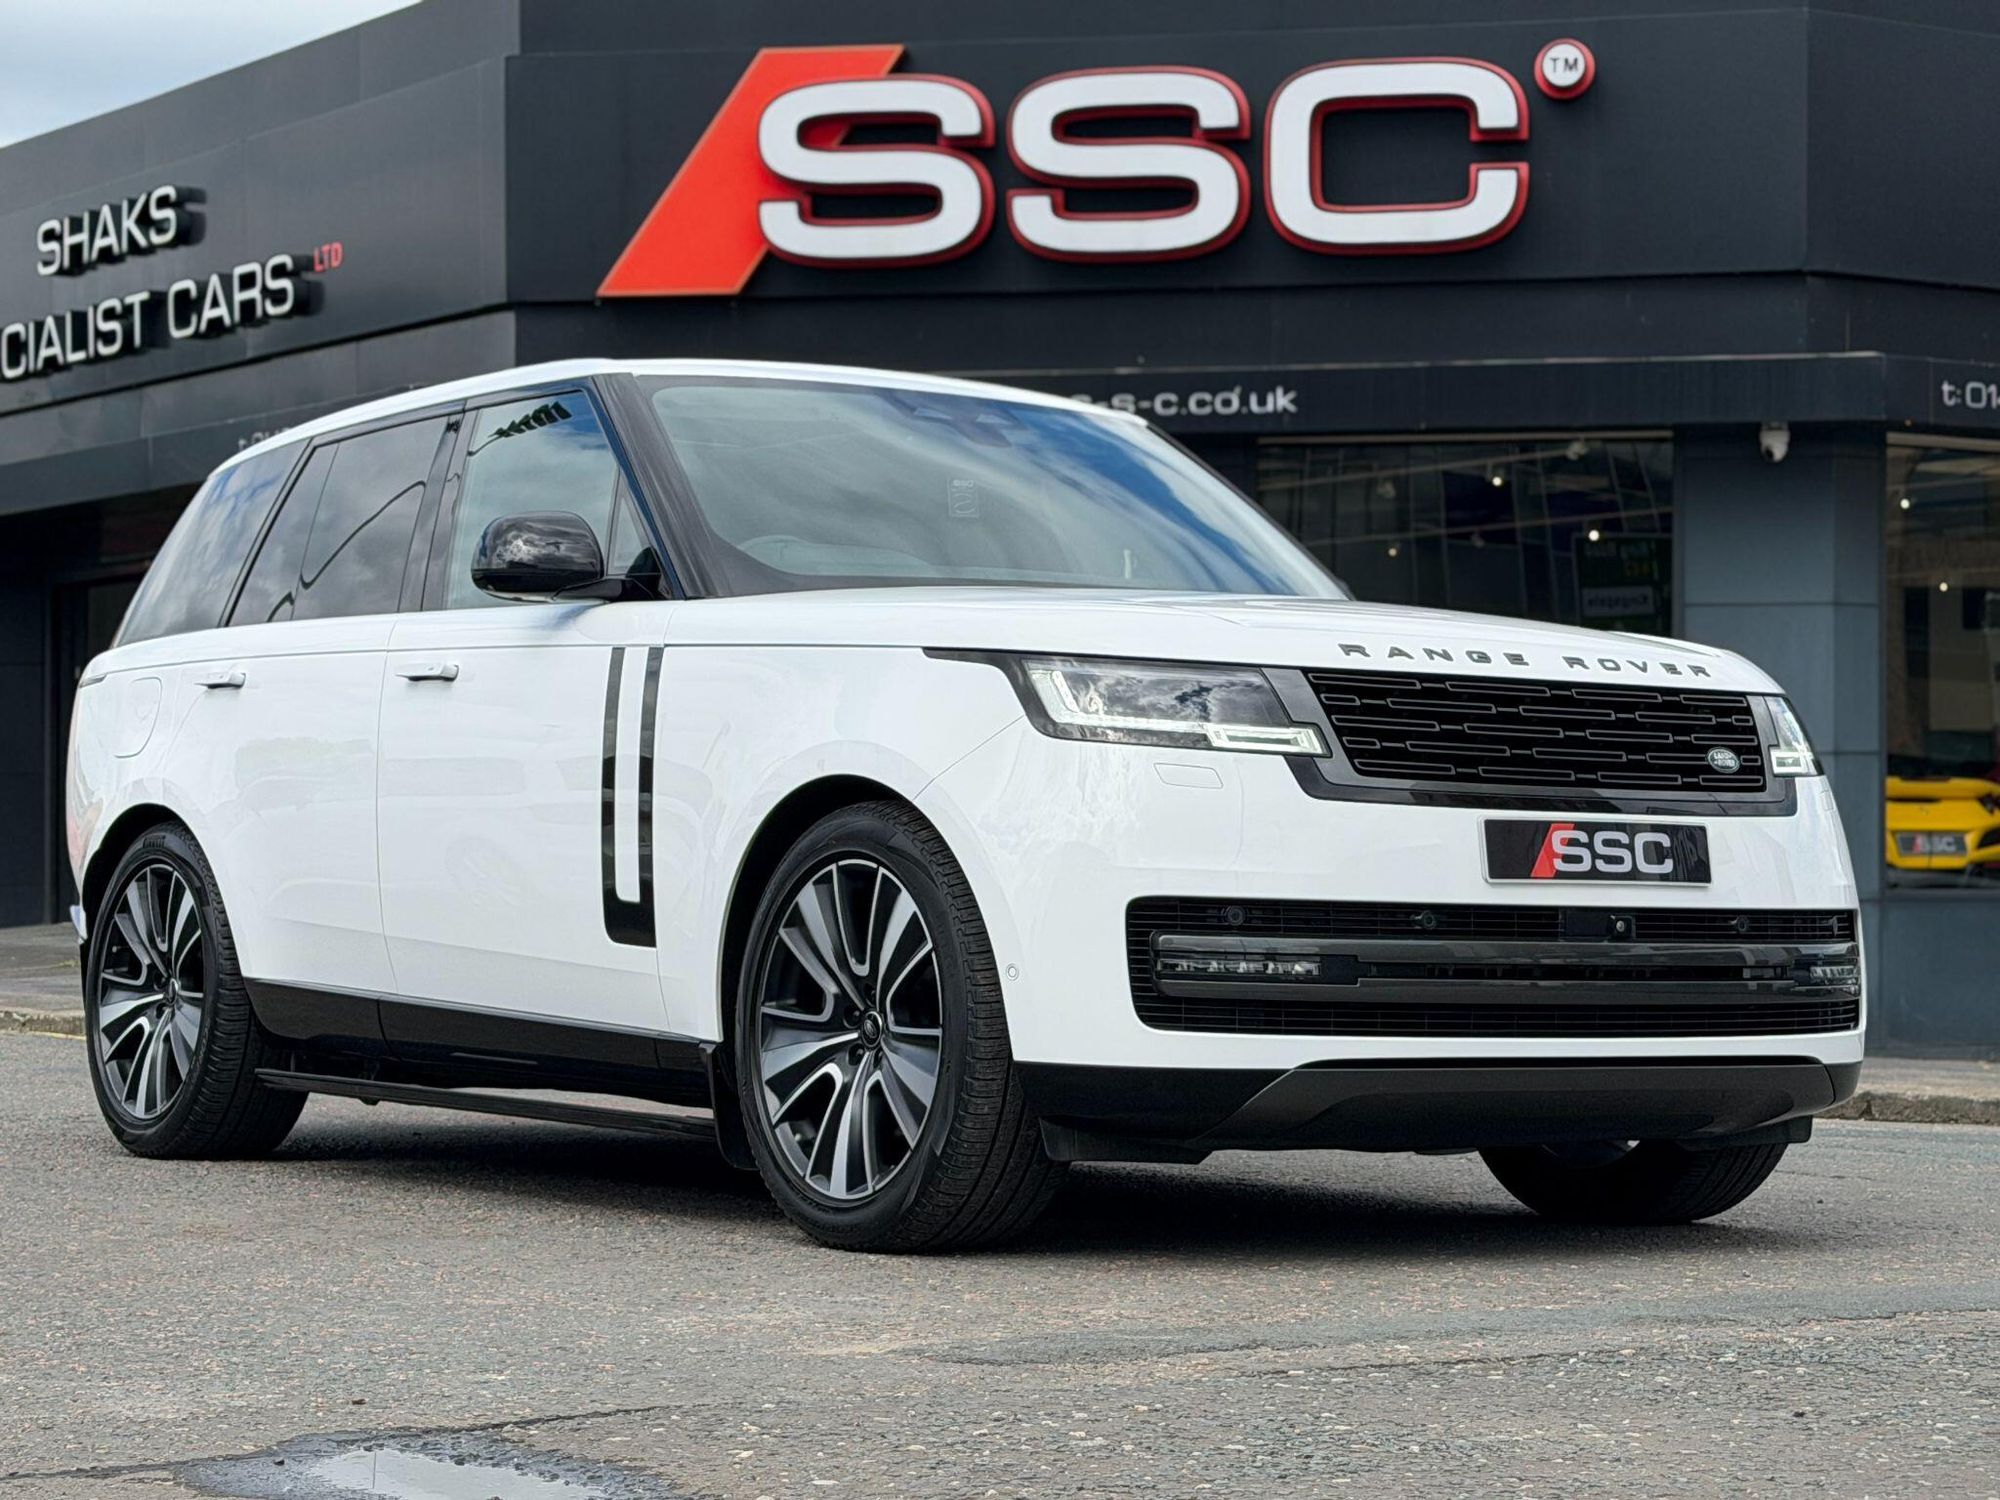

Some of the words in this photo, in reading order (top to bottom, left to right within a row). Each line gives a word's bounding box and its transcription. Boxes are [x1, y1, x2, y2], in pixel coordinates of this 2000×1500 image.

[1550, 57, 1578, 73] TM
[757, 57, 1530, 268] SSC
[36, 185, 178, 276] SHAKS
[0, 291, 150, 379] CIALIST
[167, 254, 295, 339] CARS
[313, 241, 344, 272] LTD
[1337, 643, 1530, 667] RANGE
[1562, 655, 1712, 678] ROVER
[1551, 829, 1674, 874] SSC
